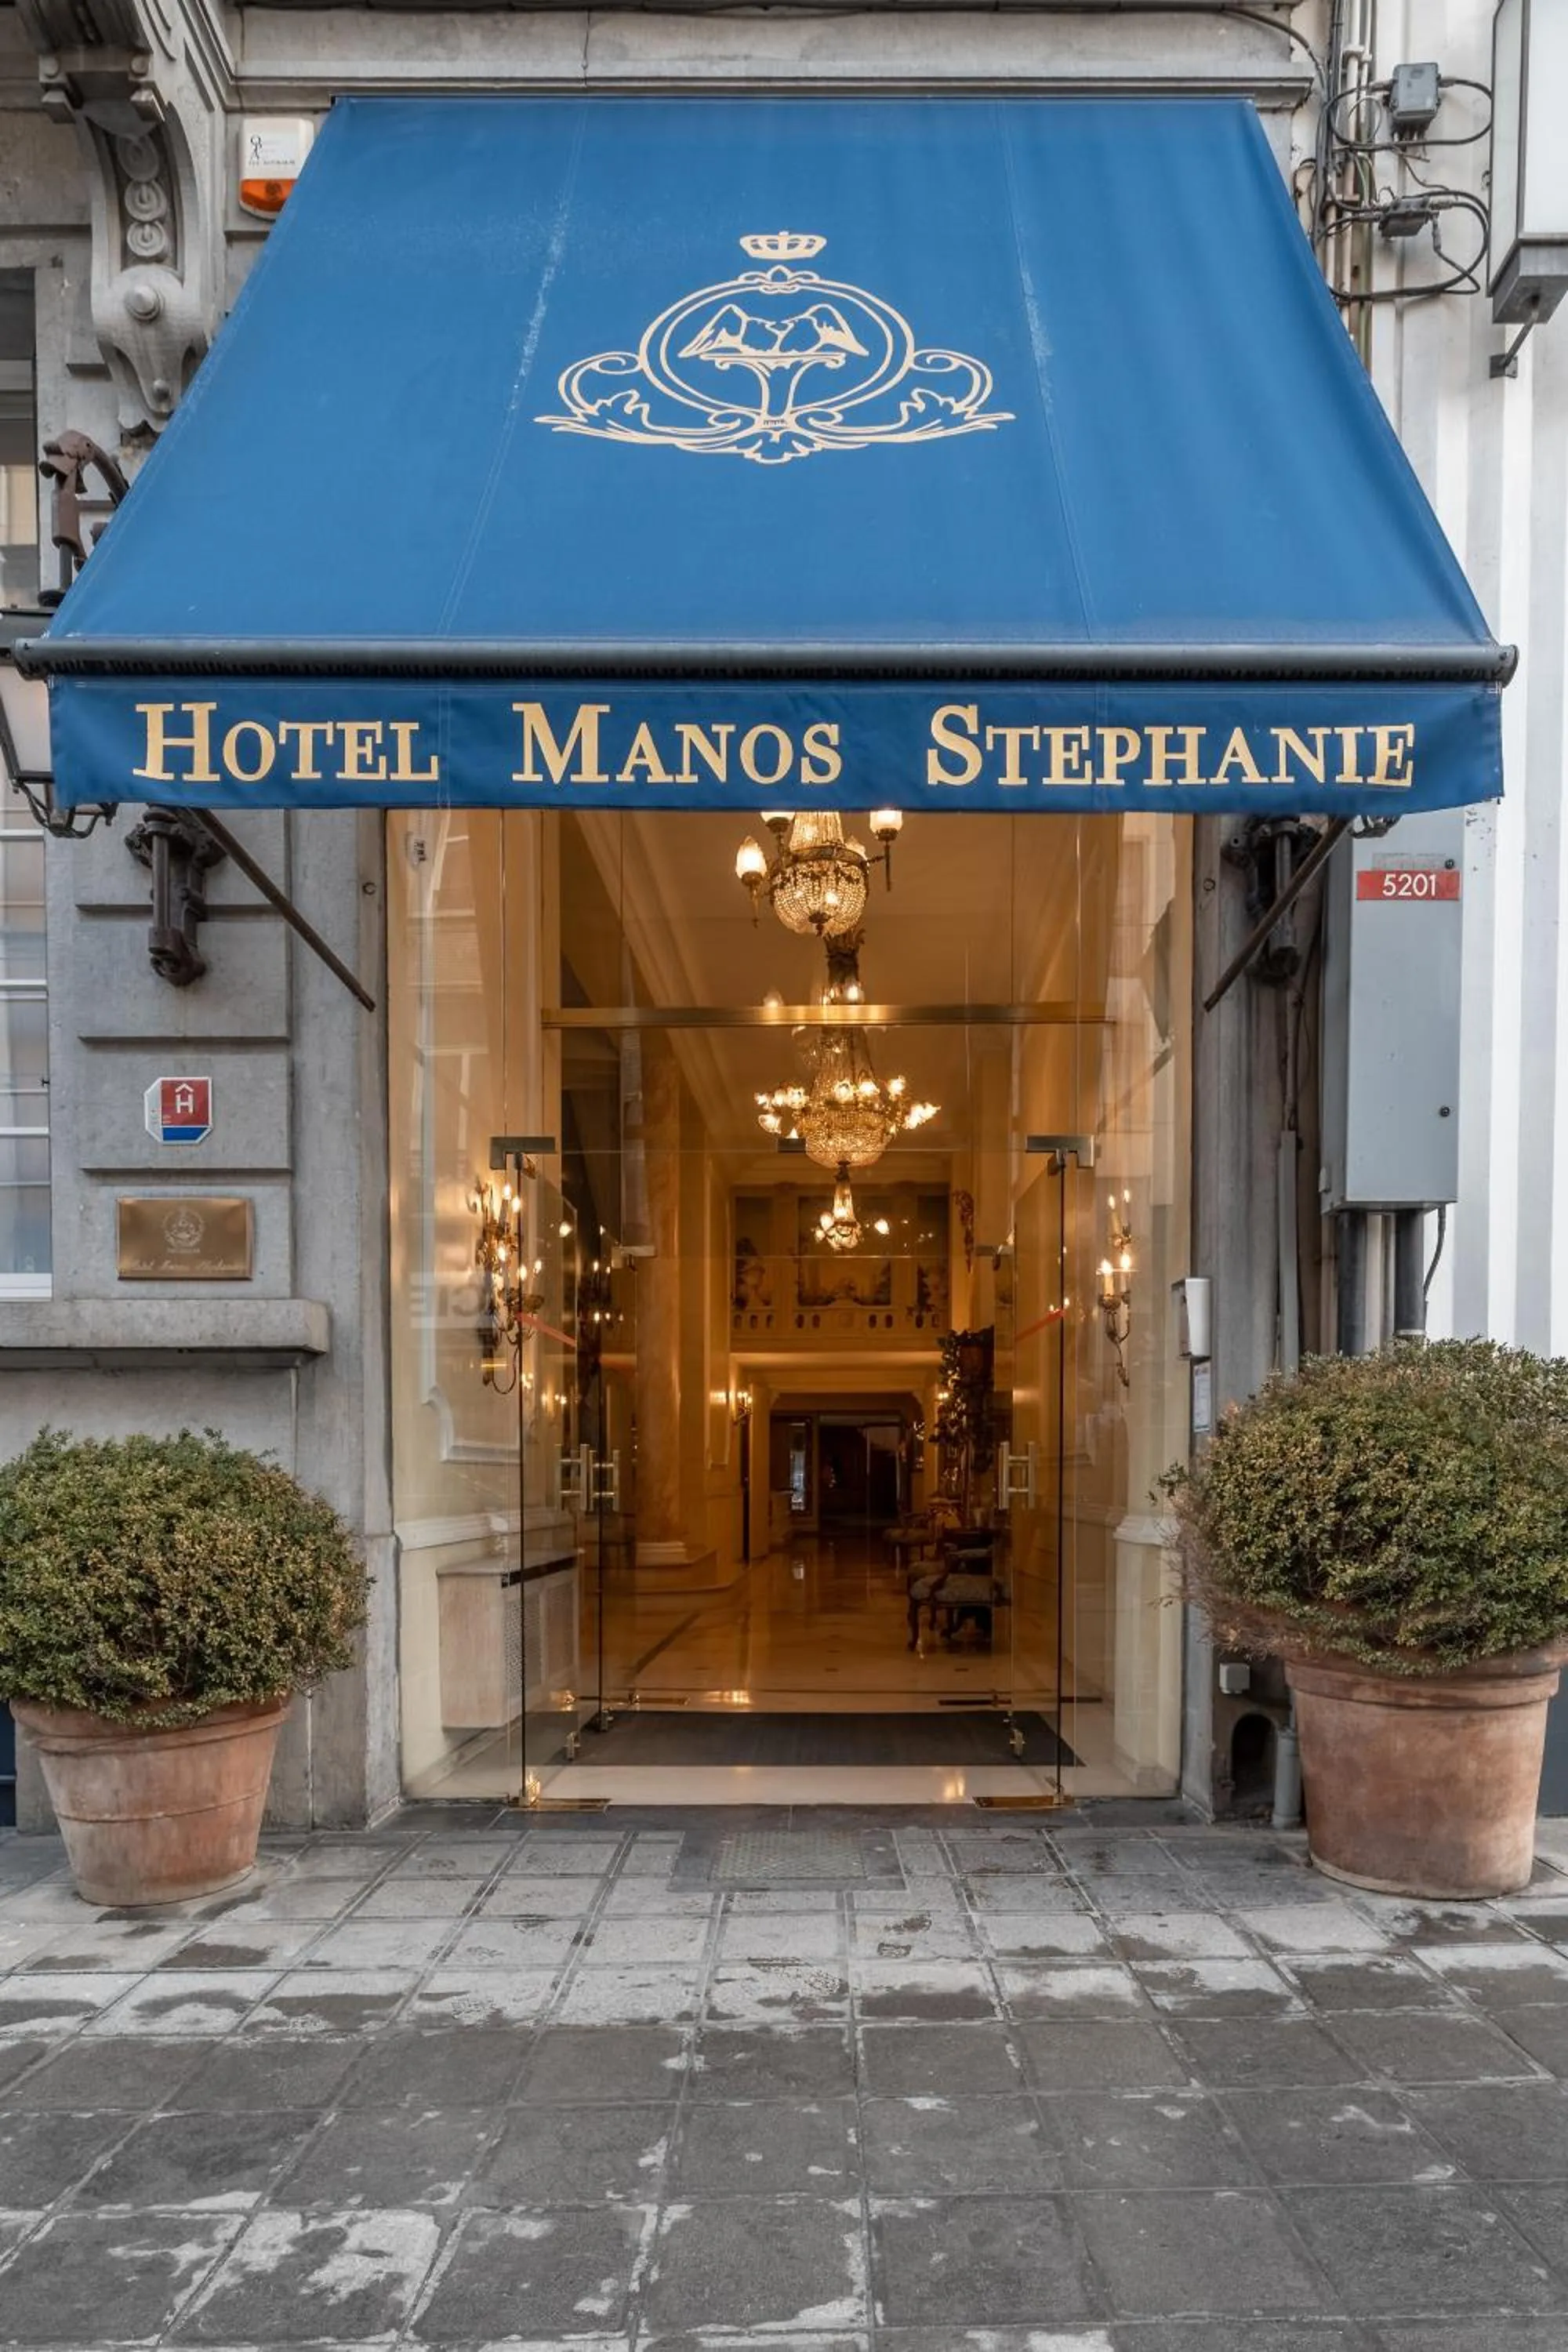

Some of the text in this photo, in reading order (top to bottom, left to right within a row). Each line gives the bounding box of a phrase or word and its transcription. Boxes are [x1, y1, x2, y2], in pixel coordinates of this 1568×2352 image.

[135, 702, 1414, 786] HOTEL MANOS STEPHANIE
[1382, 873, 1436, 896] 5201
